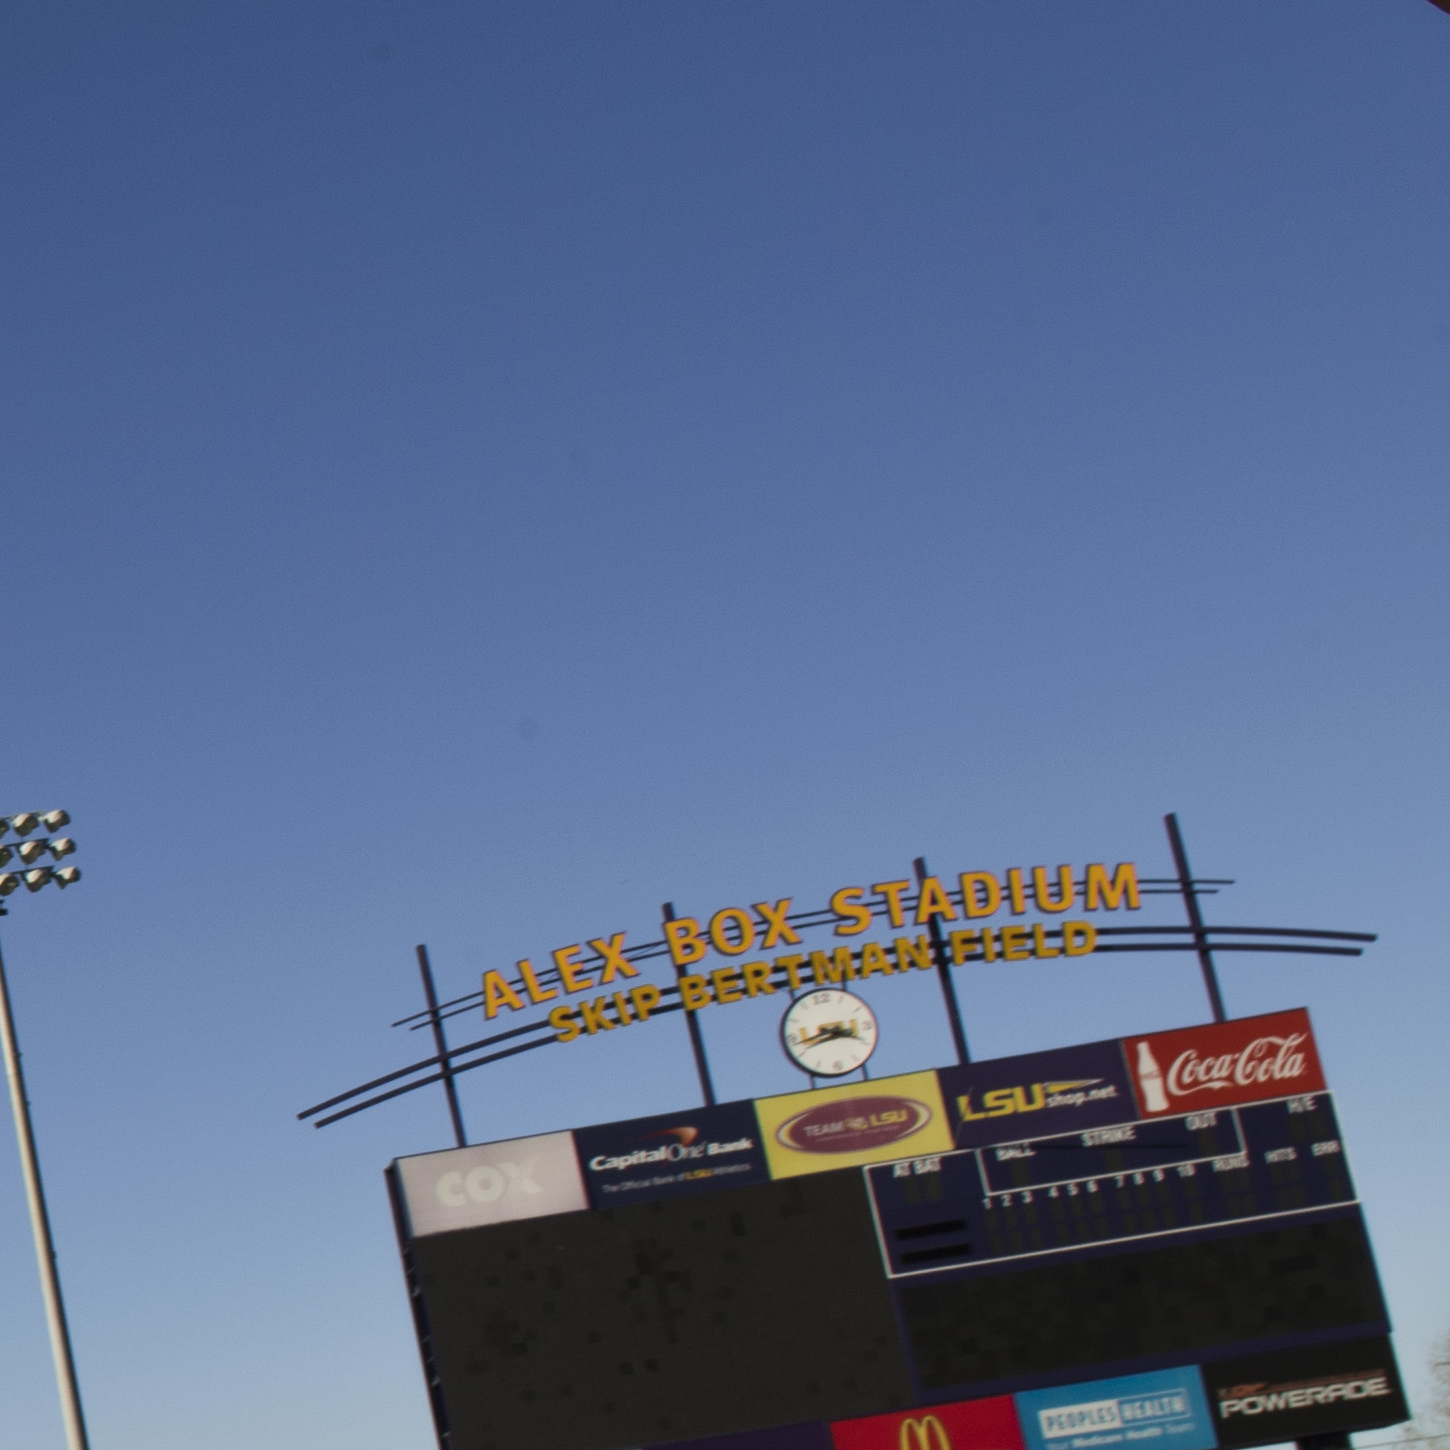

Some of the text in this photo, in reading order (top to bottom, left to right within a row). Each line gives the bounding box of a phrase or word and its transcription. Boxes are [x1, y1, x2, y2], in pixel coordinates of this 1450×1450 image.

[483, 862, 1142, 1021] ALEX BOX STADIUM
[549, 920, 1097, 1043] SKIP BERTMAN FIELD
[804, 1121, 844, 1137] TEAM
[869, 1109, 910, 1127] LSU
[1081, 1125, 1137, 1147] STRIKE
[1185, 1111, 1216, 1131] OUT
[707, 1137, 754, 1156] Bank
[436, 1157, 544, 1208] COX
[1001, 1193, 1012, 1207] 2
[1022, 1190, 1033, 1203] 3
[1048, 1185, 1059, 1198] 4
[1066, 1182, 1078, 1196] 5
[1114, 1175, 1125, 1188] 7
[1176, 1163, 1196, 1178] 10
[1046, 1396, 1186, 1432] PEOPLES HEALTH
[1219, 1376, 1392, 1419] POWERADE
